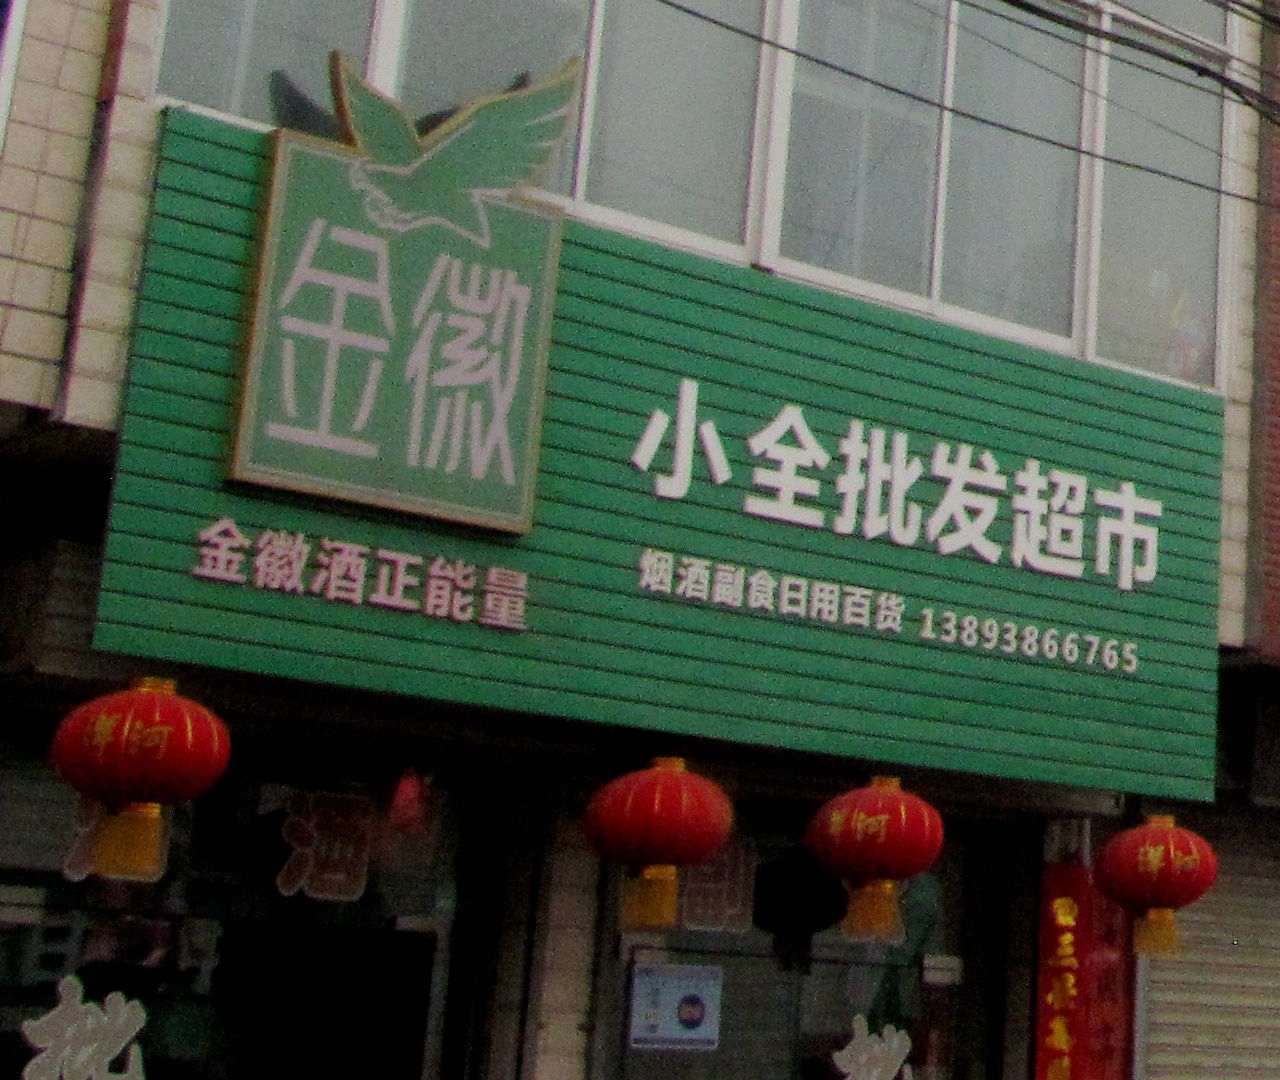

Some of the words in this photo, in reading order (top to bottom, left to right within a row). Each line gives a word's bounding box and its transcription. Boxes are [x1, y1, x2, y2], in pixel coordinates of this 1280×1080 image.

[631, 377, 1163, 592] 小全批发超市
[193, 518, 528, 631] 金徽酒正能量
[639, 547, 906, 633] 烟酒副食日用百货
[919, 607, 1140, 674] 13893866765
